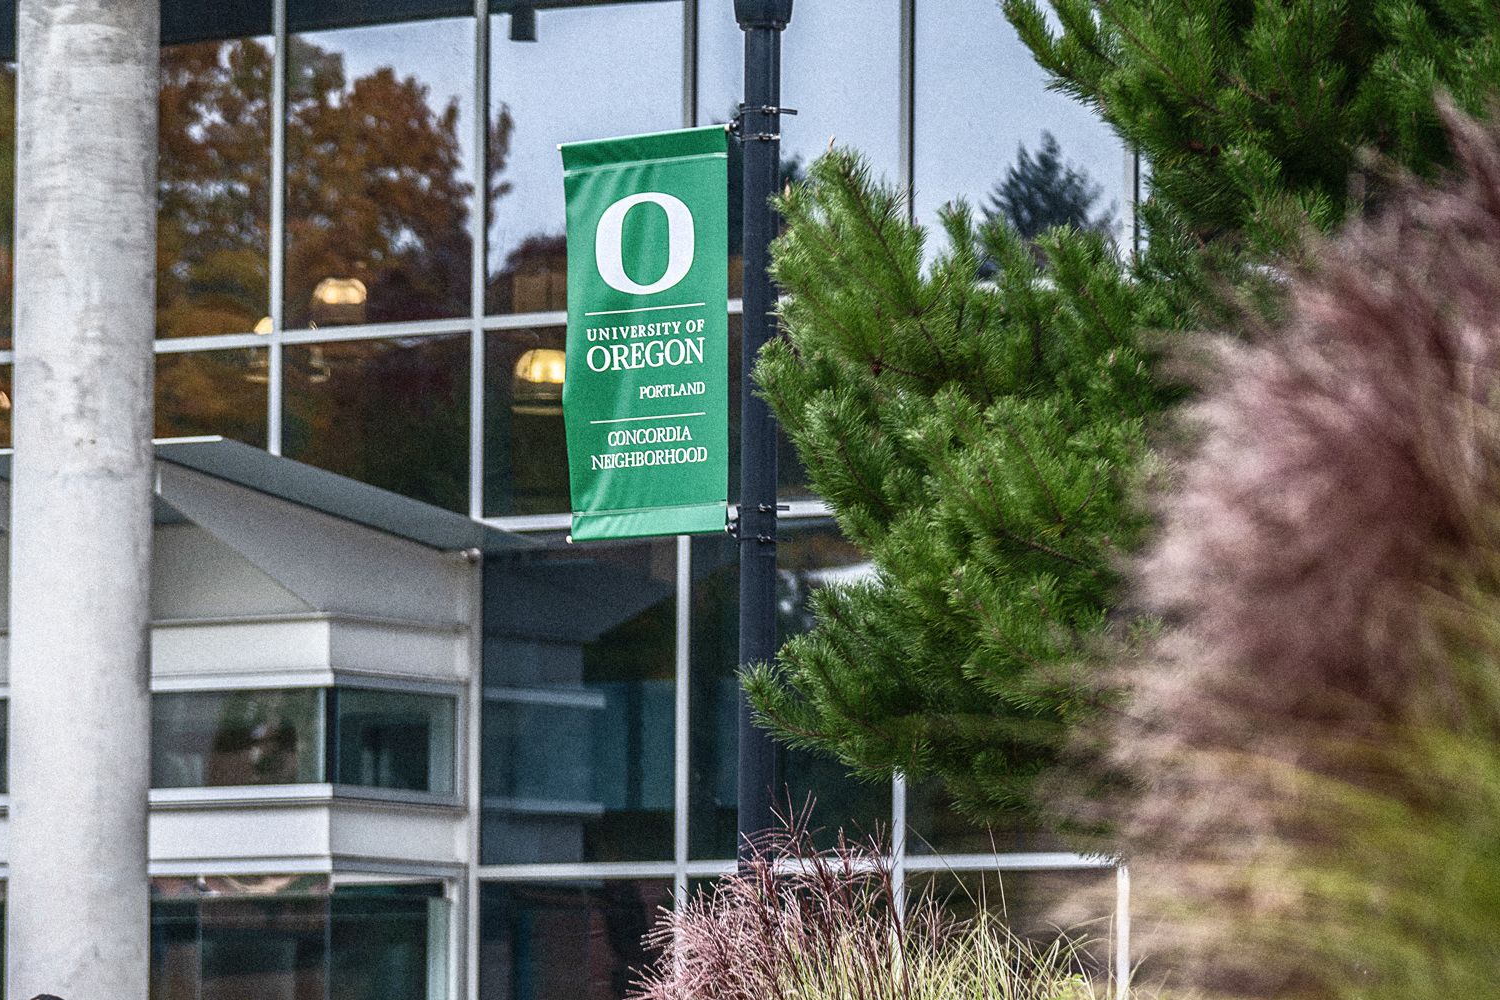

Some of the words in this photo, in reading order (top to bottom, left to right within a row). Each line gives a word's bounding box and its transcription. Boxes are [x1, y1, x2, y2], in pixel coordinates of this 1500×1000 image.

[595, 191, 695, 295] O
[586, 321, 682, 342] UNIVERSITY
[685, 318, 706, 335] OF
[586, 336, 706, 372] OREGON
[639, 381, 706, 400] PORTLAND
[607, 425, 693, 447] CONCORDIA
[590, 446, 708, 470] NEIGHBORHOOD
